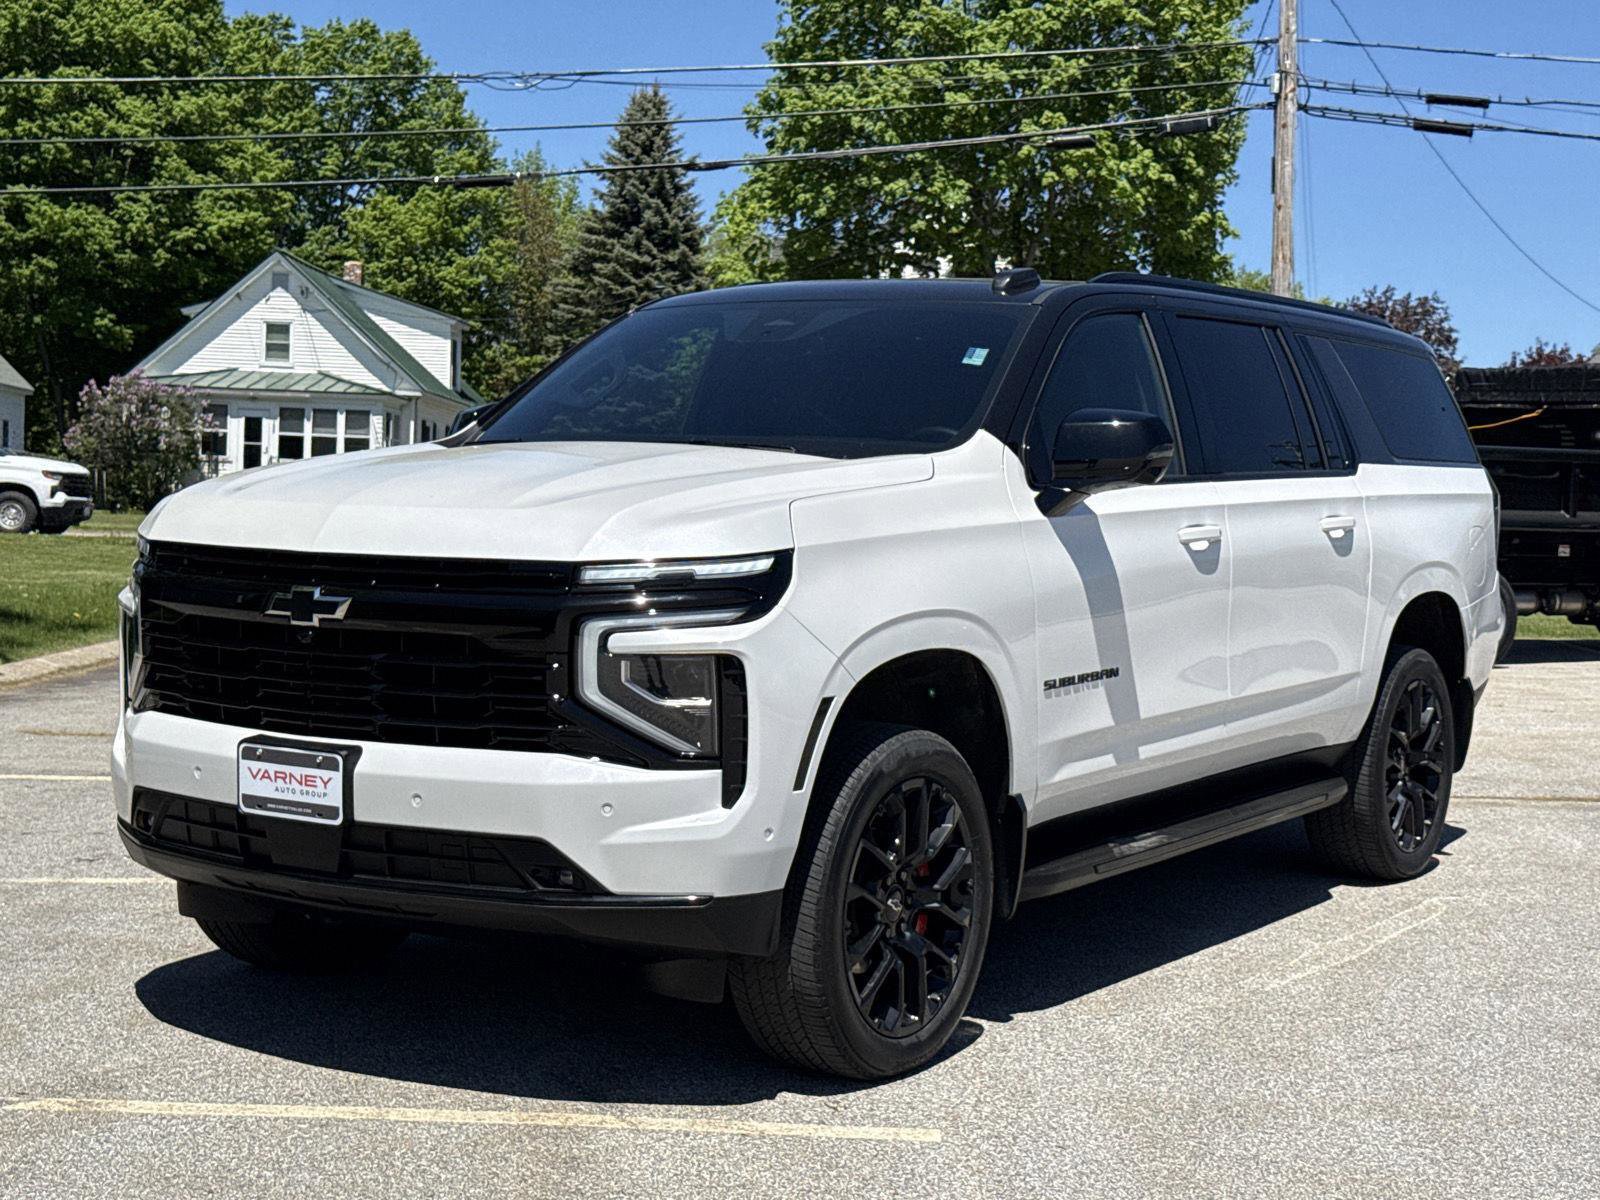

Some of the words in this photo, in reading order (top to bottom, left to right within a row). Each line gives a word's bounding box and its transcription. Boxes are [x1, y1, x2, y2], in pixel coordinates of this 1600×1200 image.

[1043, 667, 1119, 691] SUBURBAN
[247, 766, 333, 790] VARNEY
[274, 786, 297, 796] AUTO
[300, 788, 328, 799] GROUP
